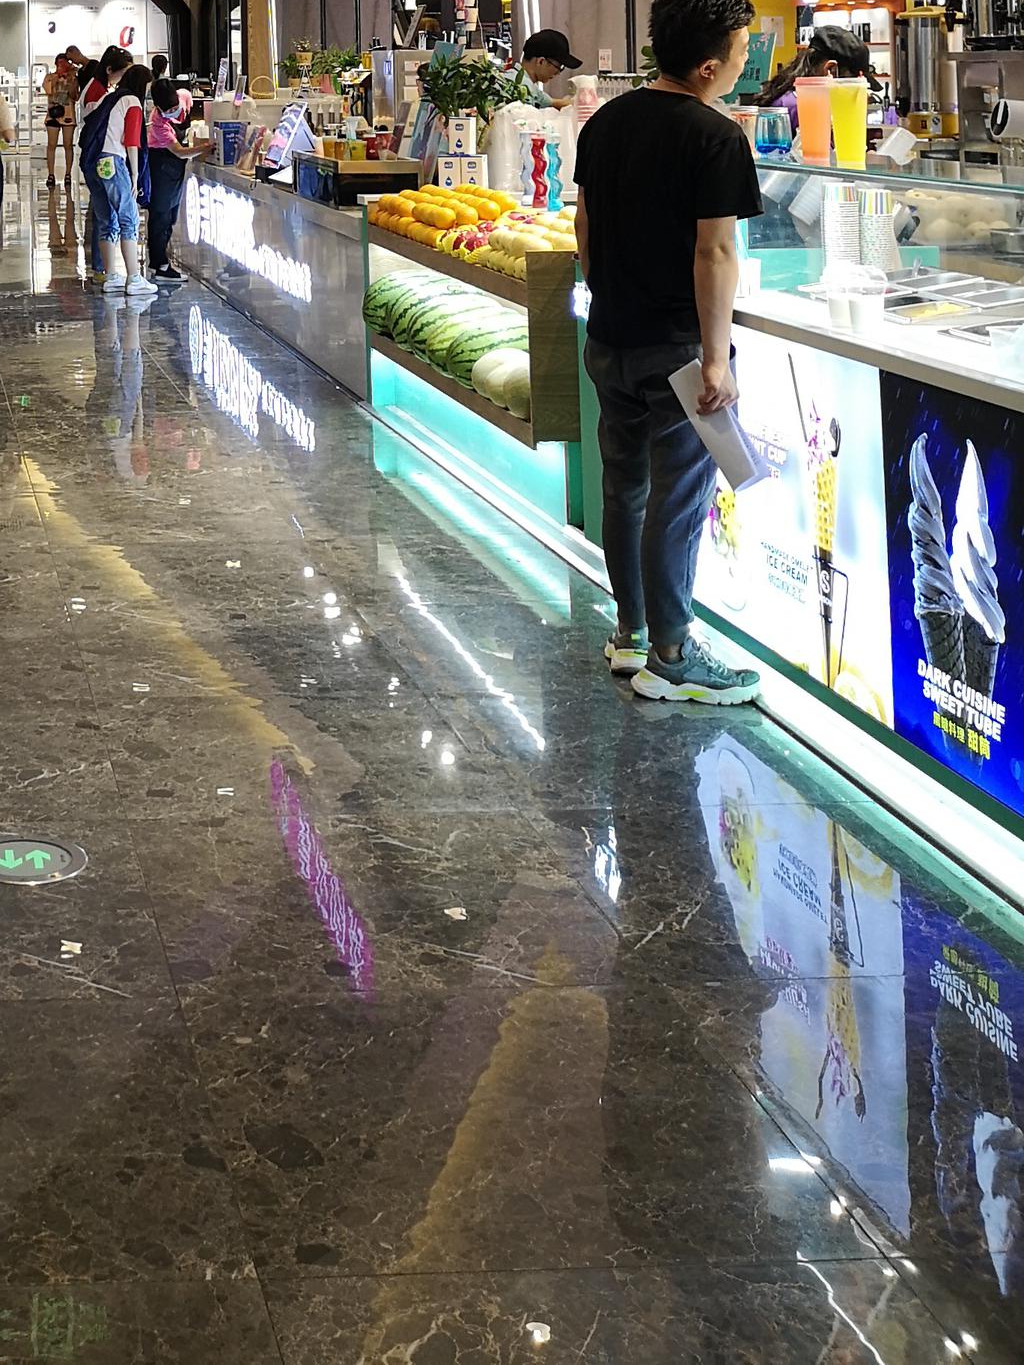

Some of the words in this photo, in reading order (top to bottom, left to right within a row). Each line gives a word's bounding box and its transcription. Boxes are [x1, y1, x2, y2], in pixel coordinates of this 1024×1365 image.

[767, 553, 778, 570] ICE
[780, 561, 808, 586] CREAM
[917, 658, 952, 694] DARK
[952, 679, 1006, 725] CUISINE
[922, 679, 964, 718] SWEET
[965, 705, 1002, 742] TUBE
[967, 728, 991, 760] 甜筒
